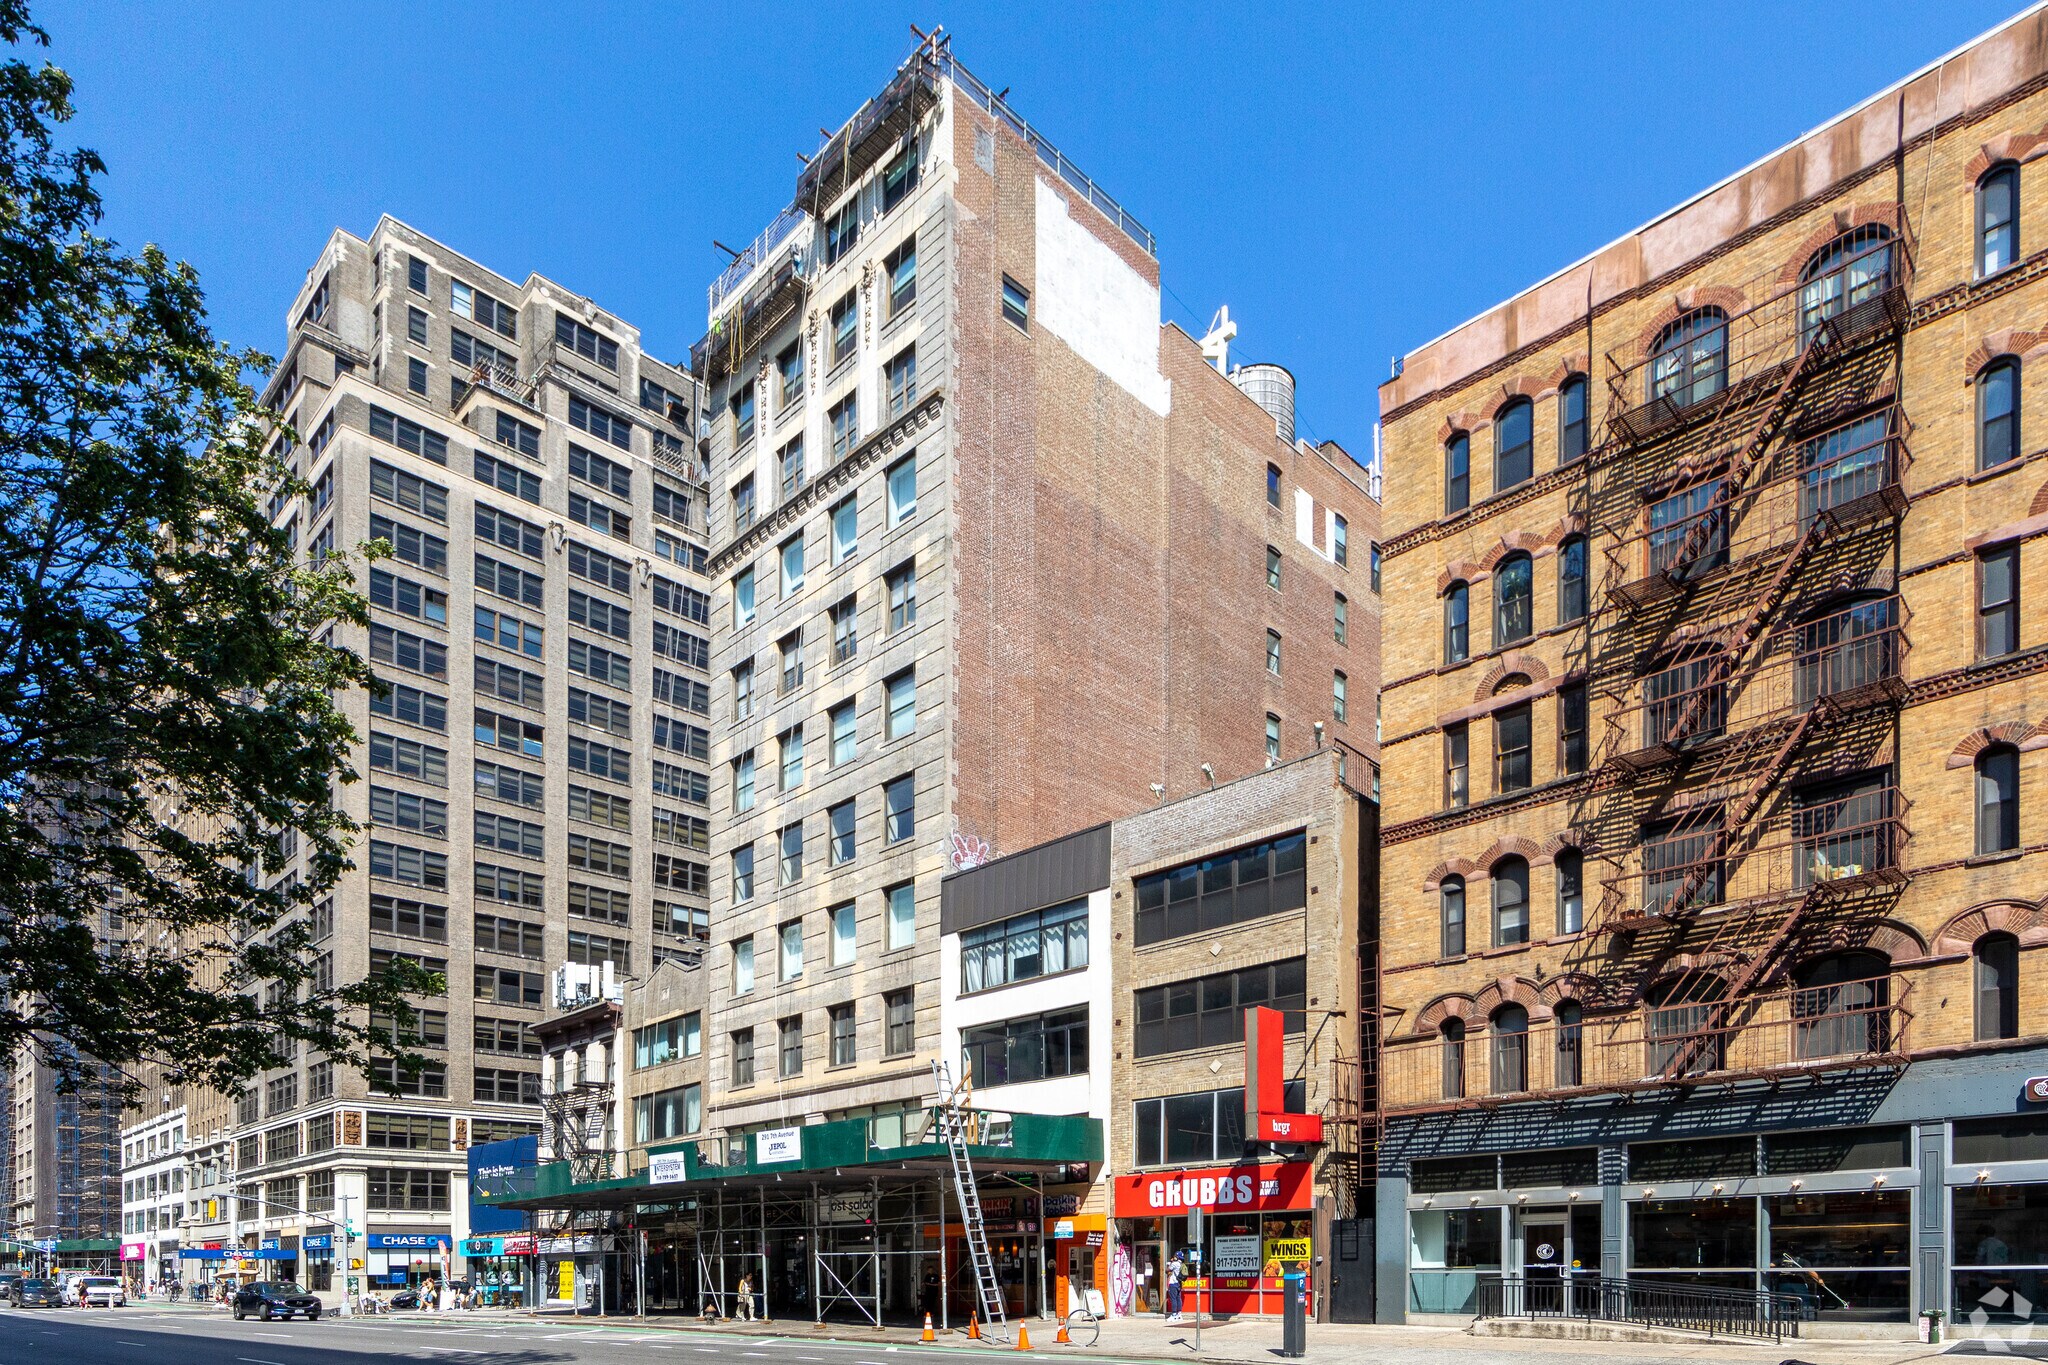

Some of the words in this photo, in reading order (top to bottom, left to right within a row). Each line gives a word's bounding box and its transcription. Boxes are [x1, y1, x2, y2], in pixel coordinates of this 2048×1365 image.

[1272, 1119, 1291, 1135] brgr
[1260, 1179, 1279, 1188] TAKE
[1149, 1175, 1253, 1208] GRUBBS
[1259, 1187, 1280, 1196] AWAY
[831, 1200, 846, 1211] ust
[980, 1197, 1013, 1209] UNKIN'
[981, 1208, 1013, 1218] ONUTS
[261, 1241, 275, 1249] CHASE
[306, 1237, 321, 1247] CHASE
[382, 1236, 426, 1245] CHASE
[1270, 1243, 1307, 1256] WINGS
[1216, 1257, 1258, 1268] 917-757-5717
[1226, 1279, 1248, 1287] LUNCH
[1299, 1279, 1304, 1287] P
